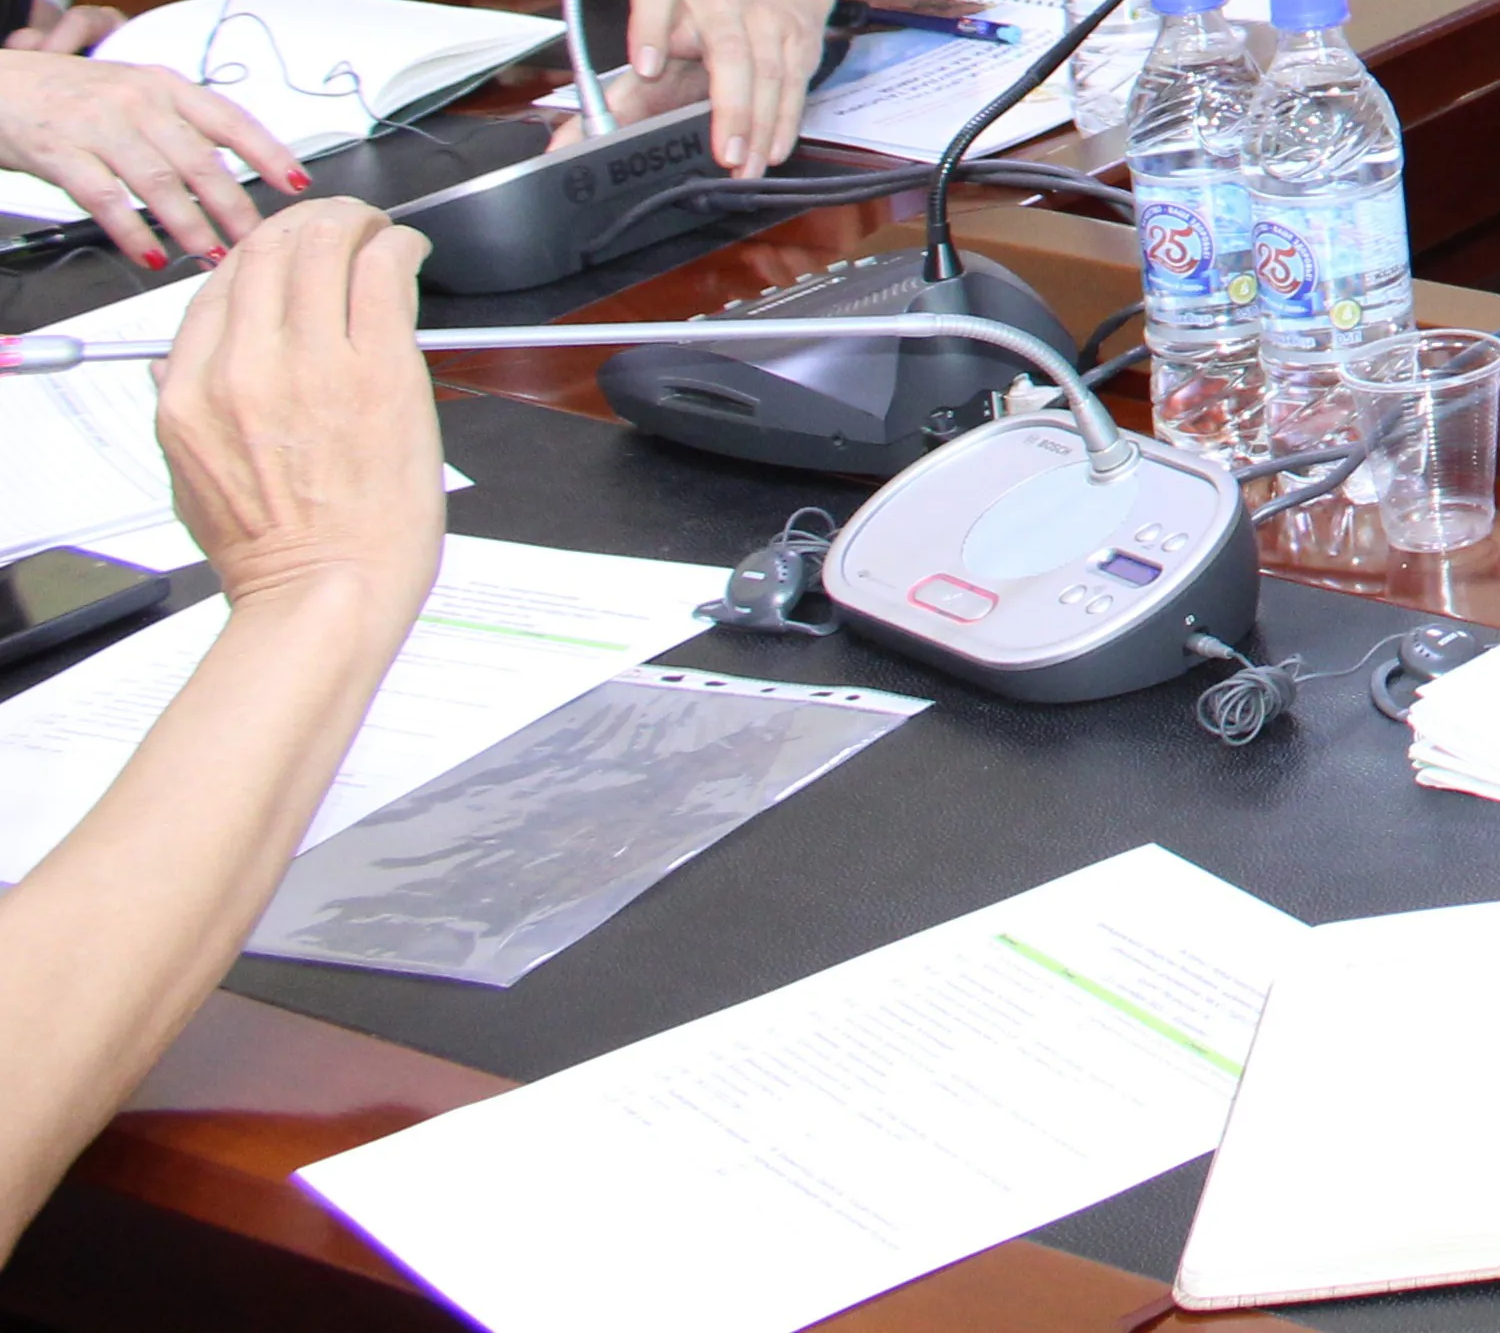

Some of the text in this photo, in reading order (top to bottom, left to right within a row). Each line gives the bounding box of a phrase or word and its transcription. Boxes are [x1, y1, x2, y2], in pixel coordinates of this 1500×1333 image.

[606, 132, 703, 186] BOSCH
[1148, 225, 1194, 264] 25
[1257, 242, 1297, 284] 25
[1037, 438, 1073, 456] BOSCH
